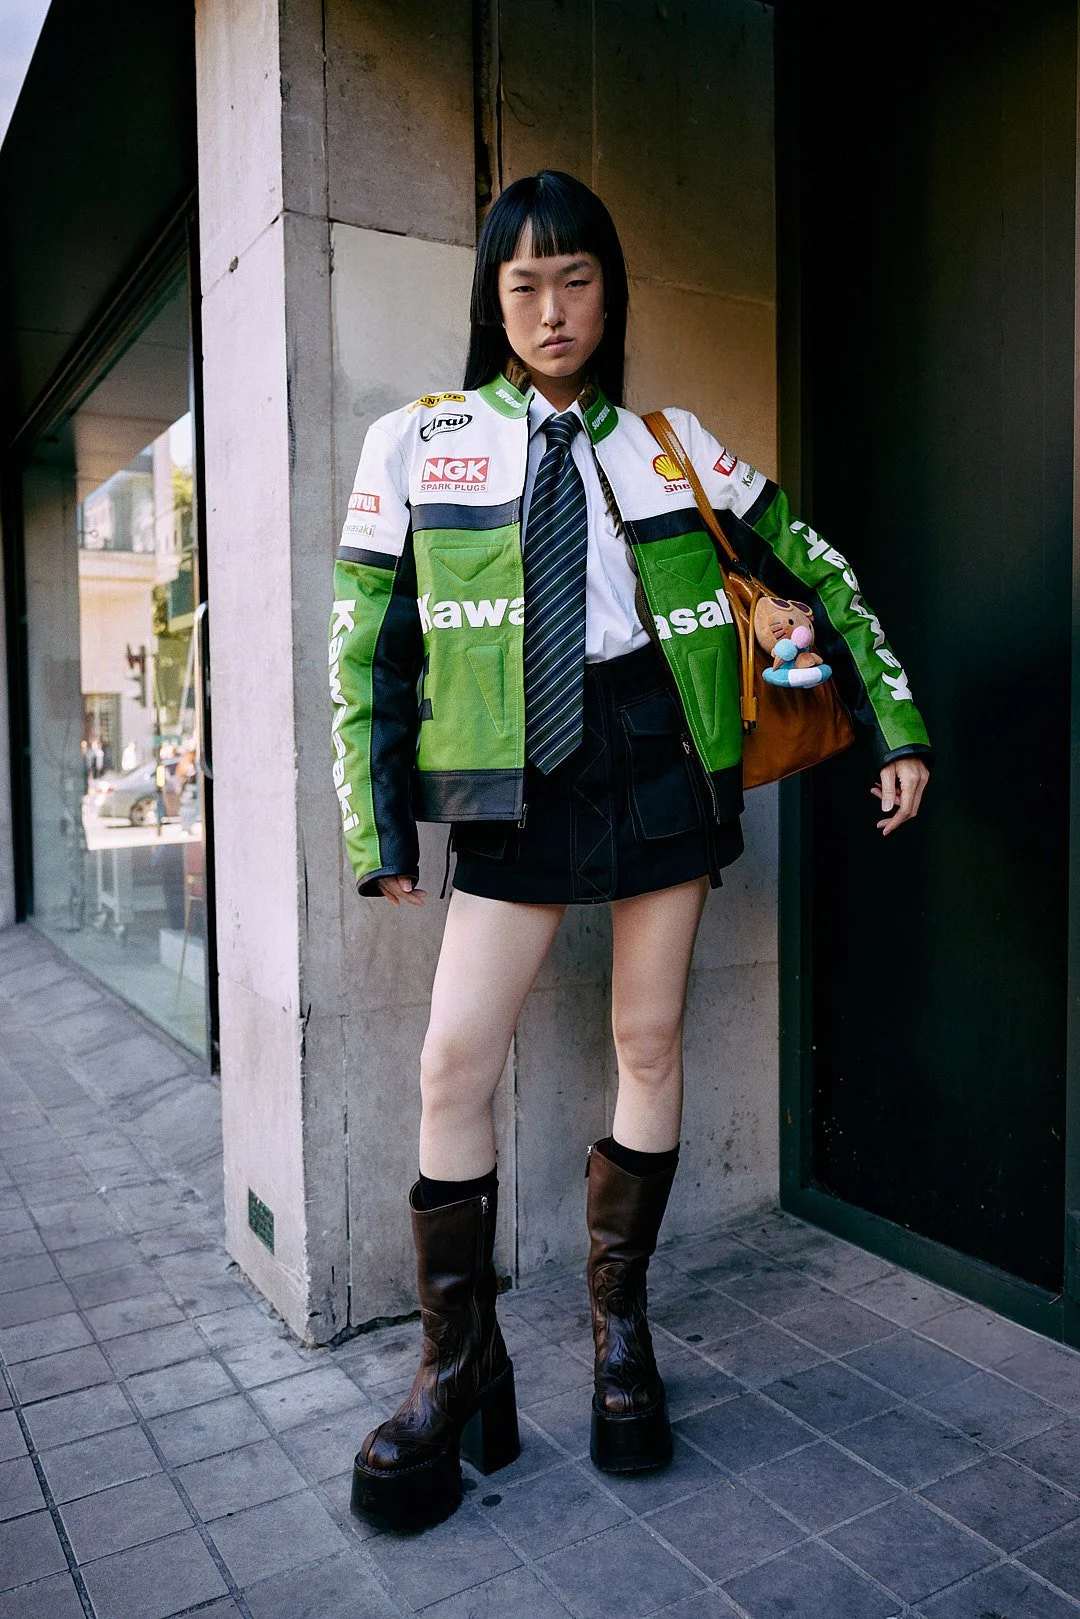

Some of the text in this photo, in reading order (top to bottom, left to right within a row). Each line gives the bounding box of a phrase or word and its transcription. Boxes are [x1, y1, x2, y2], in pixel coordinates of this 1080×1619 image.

[420, 412, 474, 442] Arai
[422, 459, 487, 482] NGK
[420, 483, 487, 492] SPARK PLUGS
[663, 483, 692, 494] She
